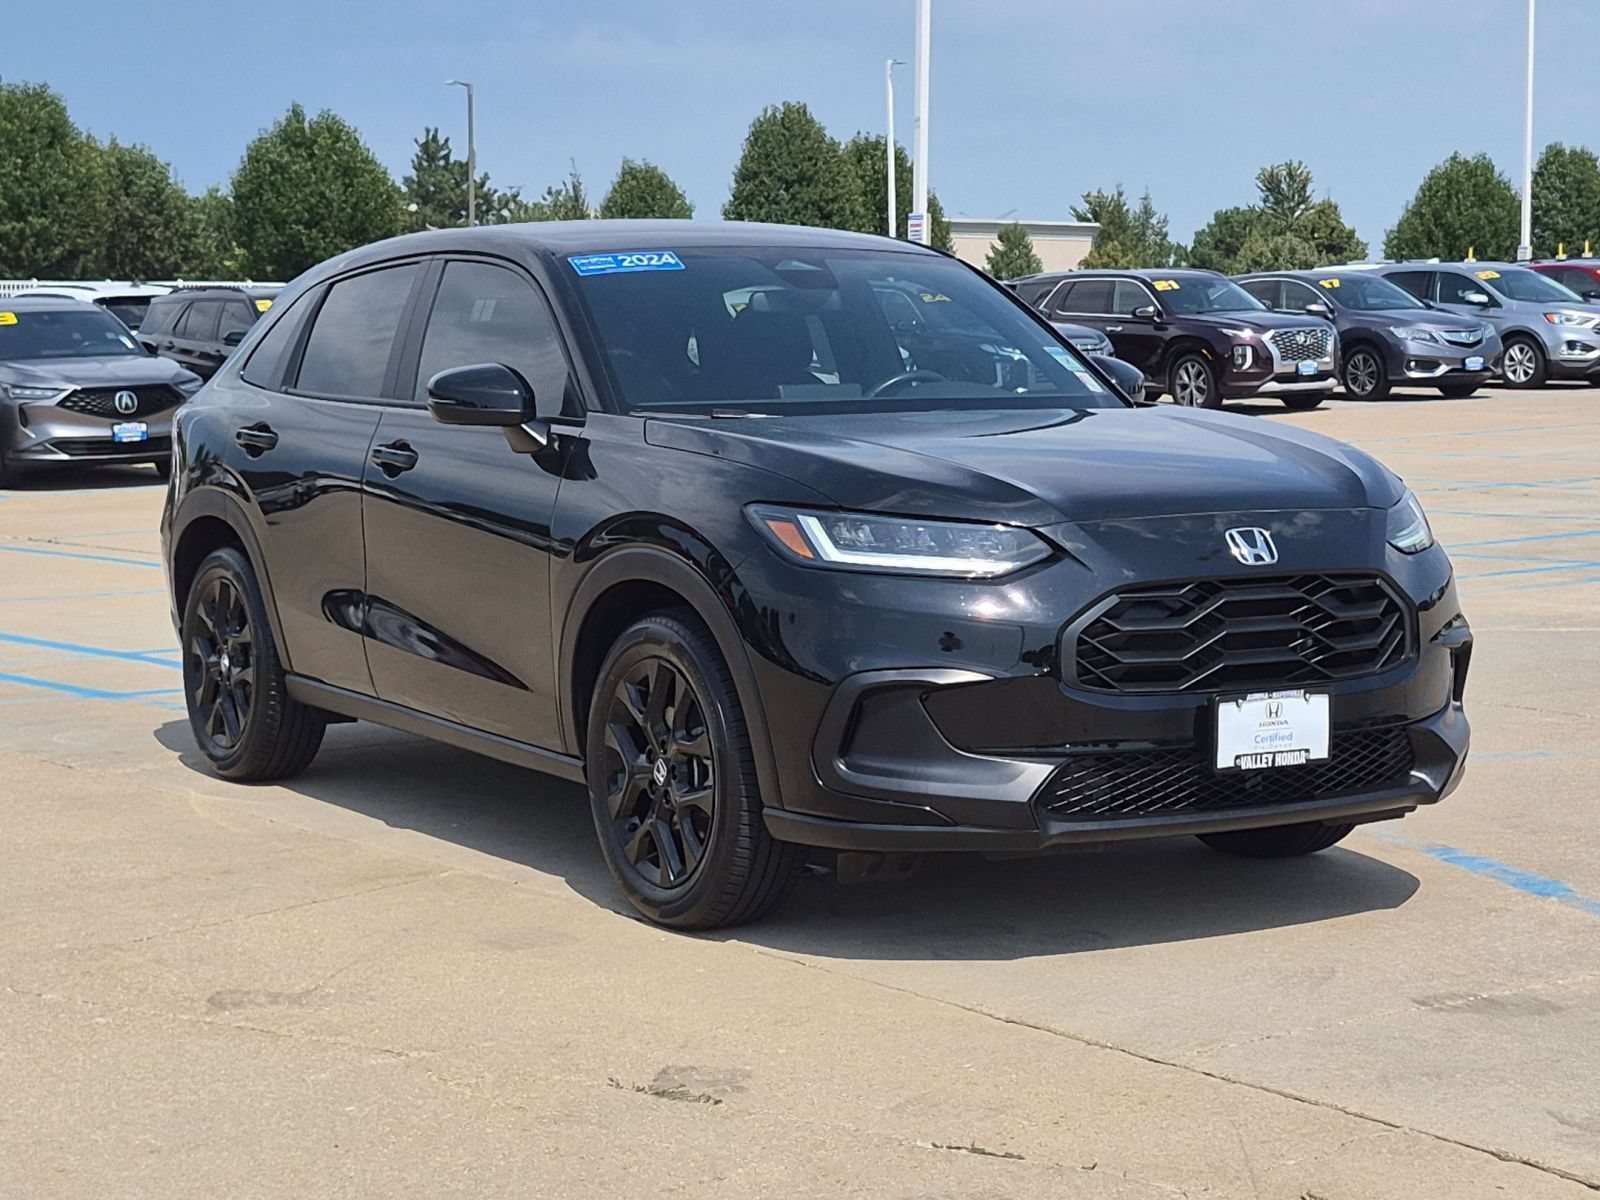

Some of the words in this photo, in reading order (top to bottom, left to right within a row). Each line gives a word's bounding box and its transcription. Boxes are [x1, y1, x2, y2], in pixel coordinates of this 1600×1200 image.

[617, 253, 676, 267] 2024
[1254, 731, 1293, 744] Certified
[1240, 753, 1274, 770] VALLEY
[1274, 750, 1306, 767] HONDA
